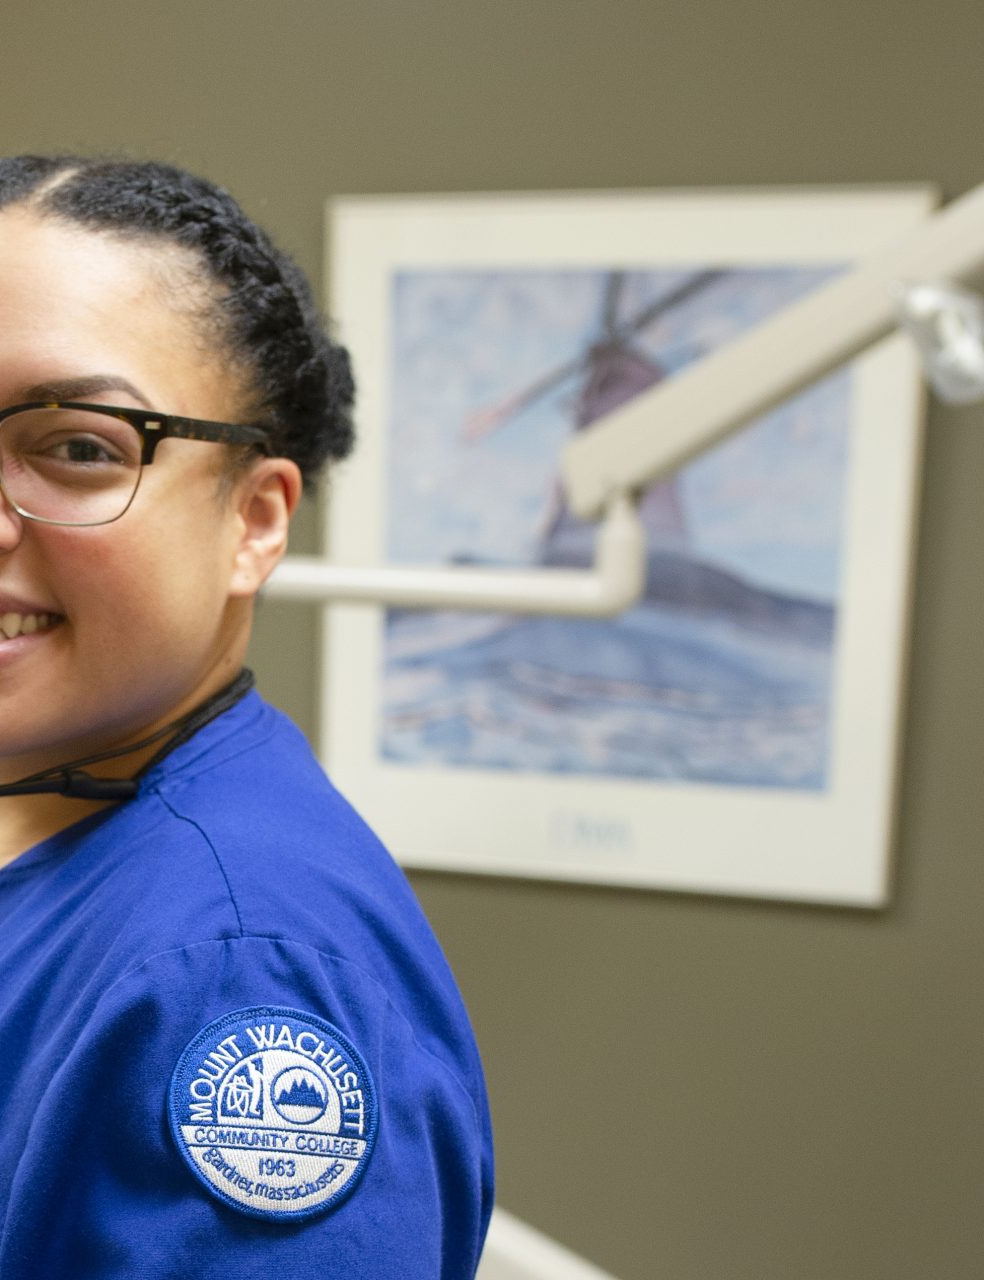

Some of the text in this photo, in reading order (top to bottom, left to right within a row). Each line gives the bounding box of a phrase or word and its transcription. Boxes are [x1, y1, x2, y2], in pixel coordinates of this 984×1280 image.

[190, 1024, 365, 1135] MOUNT WACHUSETT
[194, 1129, 359, 1156] COMMUNITY COLLEGE
[258, 1158, 296, 1177] 1963
